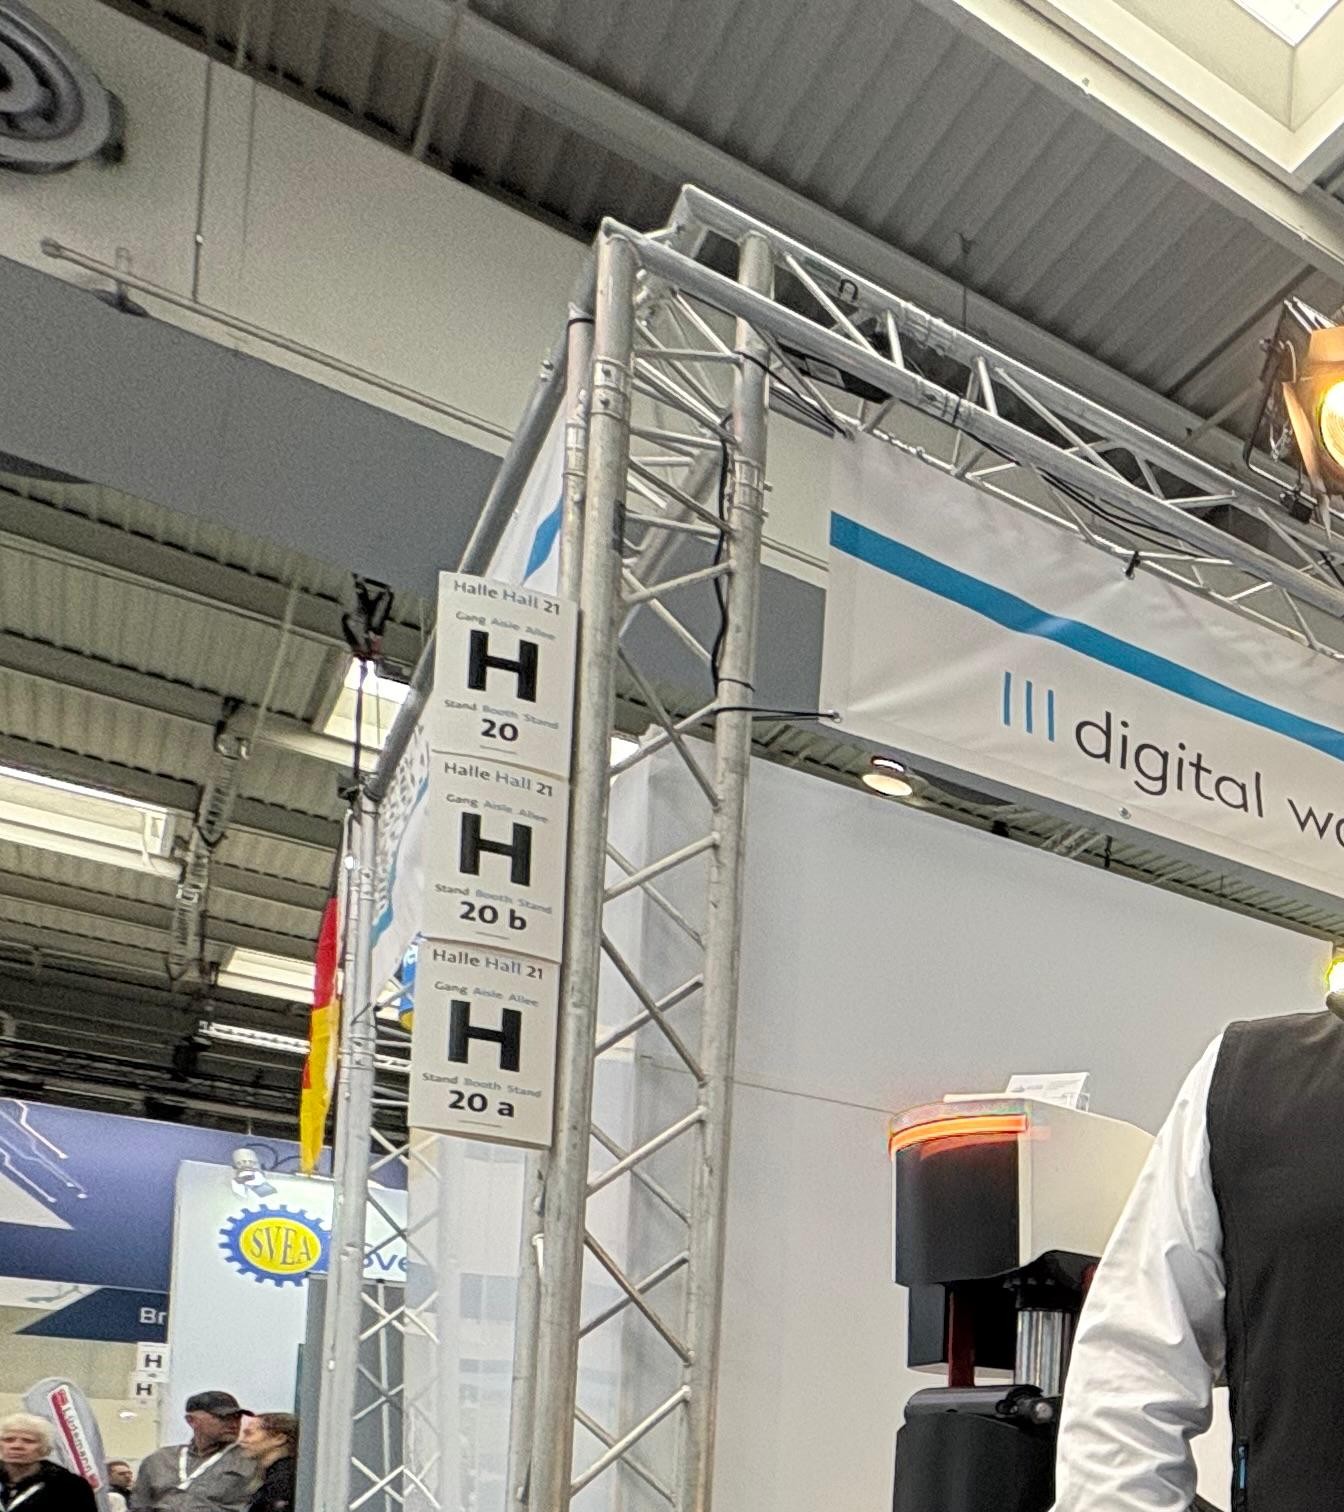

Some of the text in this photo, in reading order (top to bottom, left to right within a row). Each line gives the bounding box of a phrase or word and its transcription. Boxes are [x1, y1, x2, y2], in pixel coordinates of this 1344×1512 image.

[454, 580, 560, 615] Halle Hall 21
[467, 629, 539, 703] H
[481, 718, 519, 742] 20
[444, 761, 553, 797] Halle Hall 21
[1074, 710, 1265, 818] digital
[459, 812, 533, 887] H
[435, 883, 470, 896] Stand
[459, 901, 527, 931] 20 b
[432, 949, 543, 980] Halle Hall 21
[434, 980, 468, 996] Gang
[447, 999, 523, 1073] H
[422, 1072, 458, 1085] Stand
[448, 1090, 515, 1118] 20 a
[250, 1226, 312, 1266] SVEA
[144, 1353, 162, 1368] H
[136, 1383, 153, 1396] H
